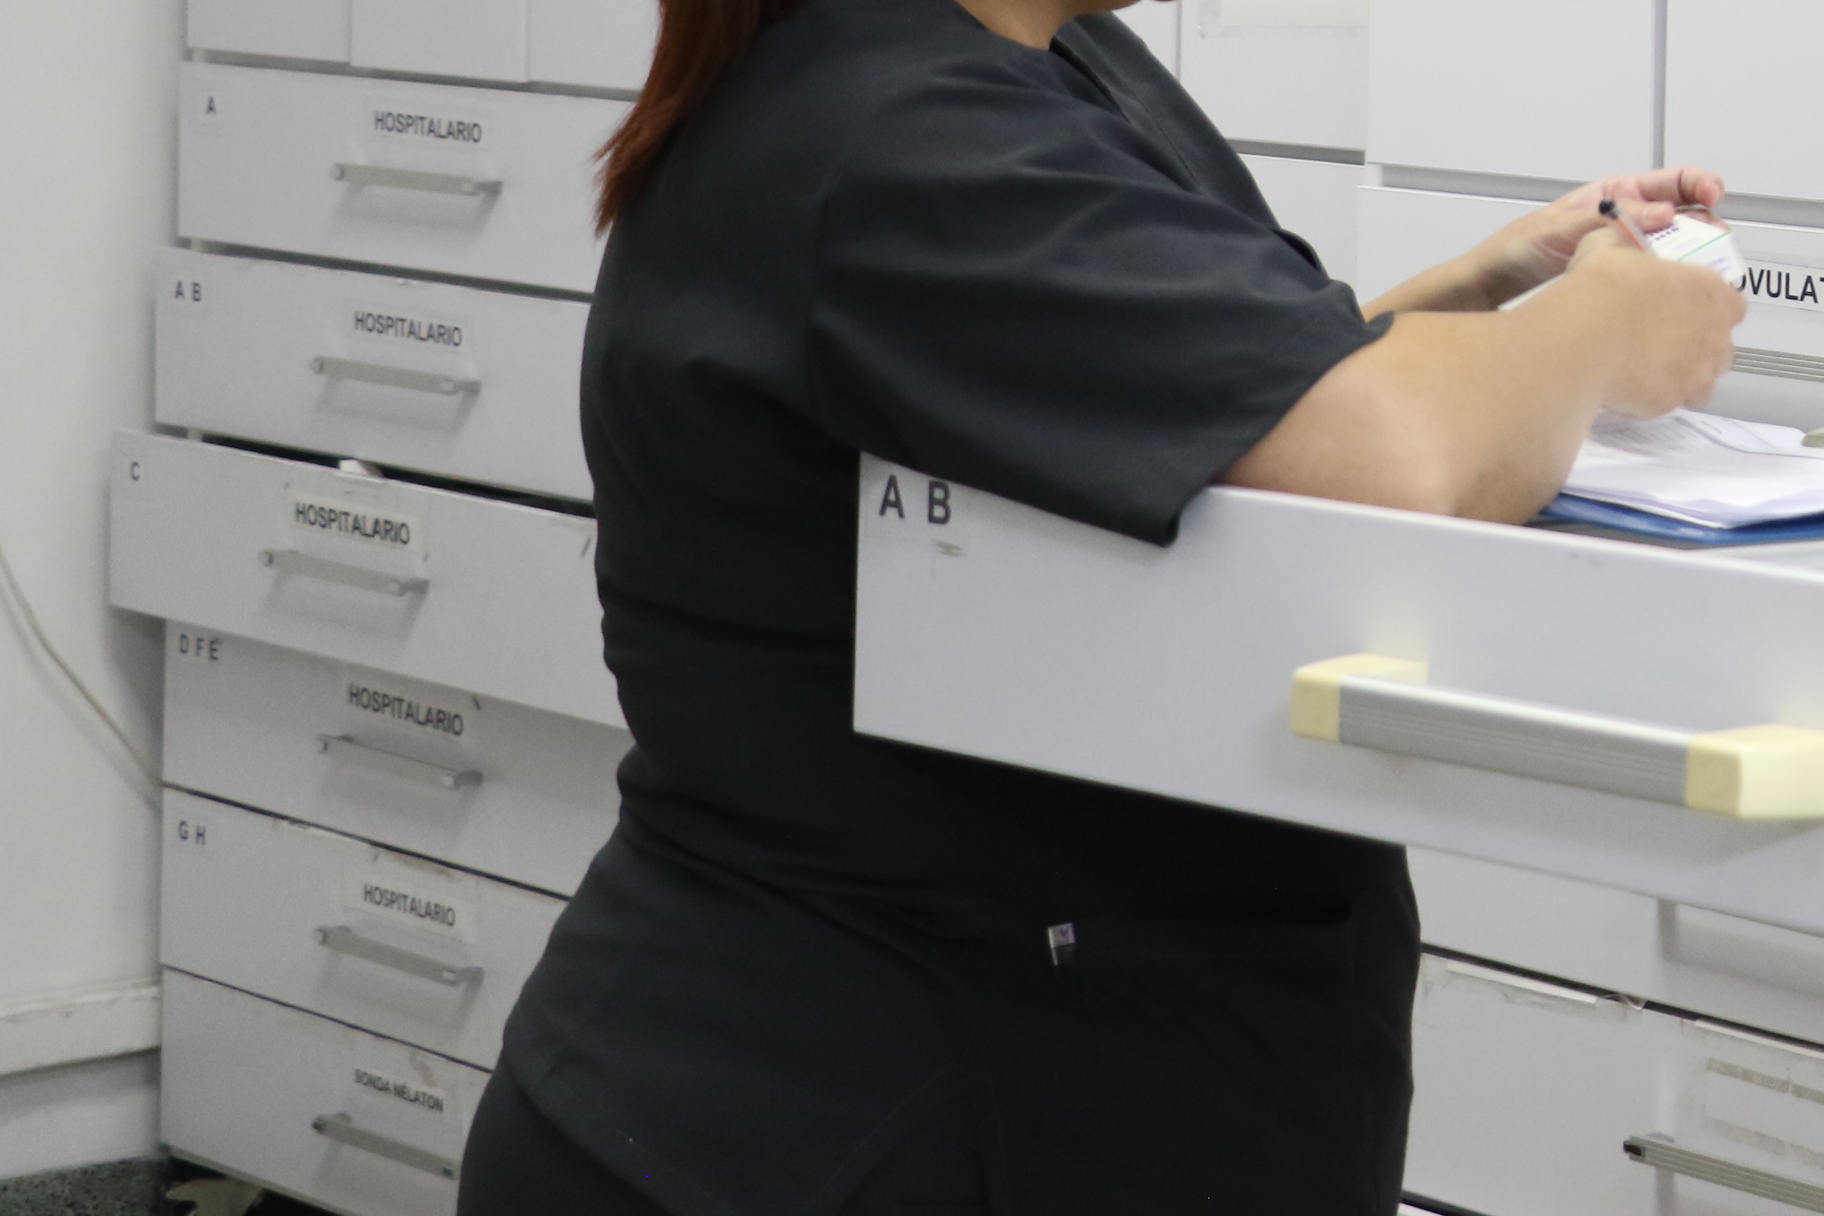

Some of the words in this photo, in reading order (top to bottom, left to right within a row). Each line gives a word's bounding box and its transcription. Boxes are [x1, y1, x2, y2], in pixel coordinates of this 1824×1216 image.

[206, 96, 216, 115] A
[374, 110, 482, 143] HOSPITALARIO
[174, 281, 185, 300] A
[192, 282, 202, 302] B
[354, 310, 463, 347] HOSPITALARIO
[130, 461, 141, 481] C
[879, 474, 905, 519] A
[928, 480, 951, 525] B
[295, 501, 411, 545] HOSPITALARIO
[348, 683, 464, 737] HOSPITALARIO
[363, 884, 457, 927] HOSPITALARIO
